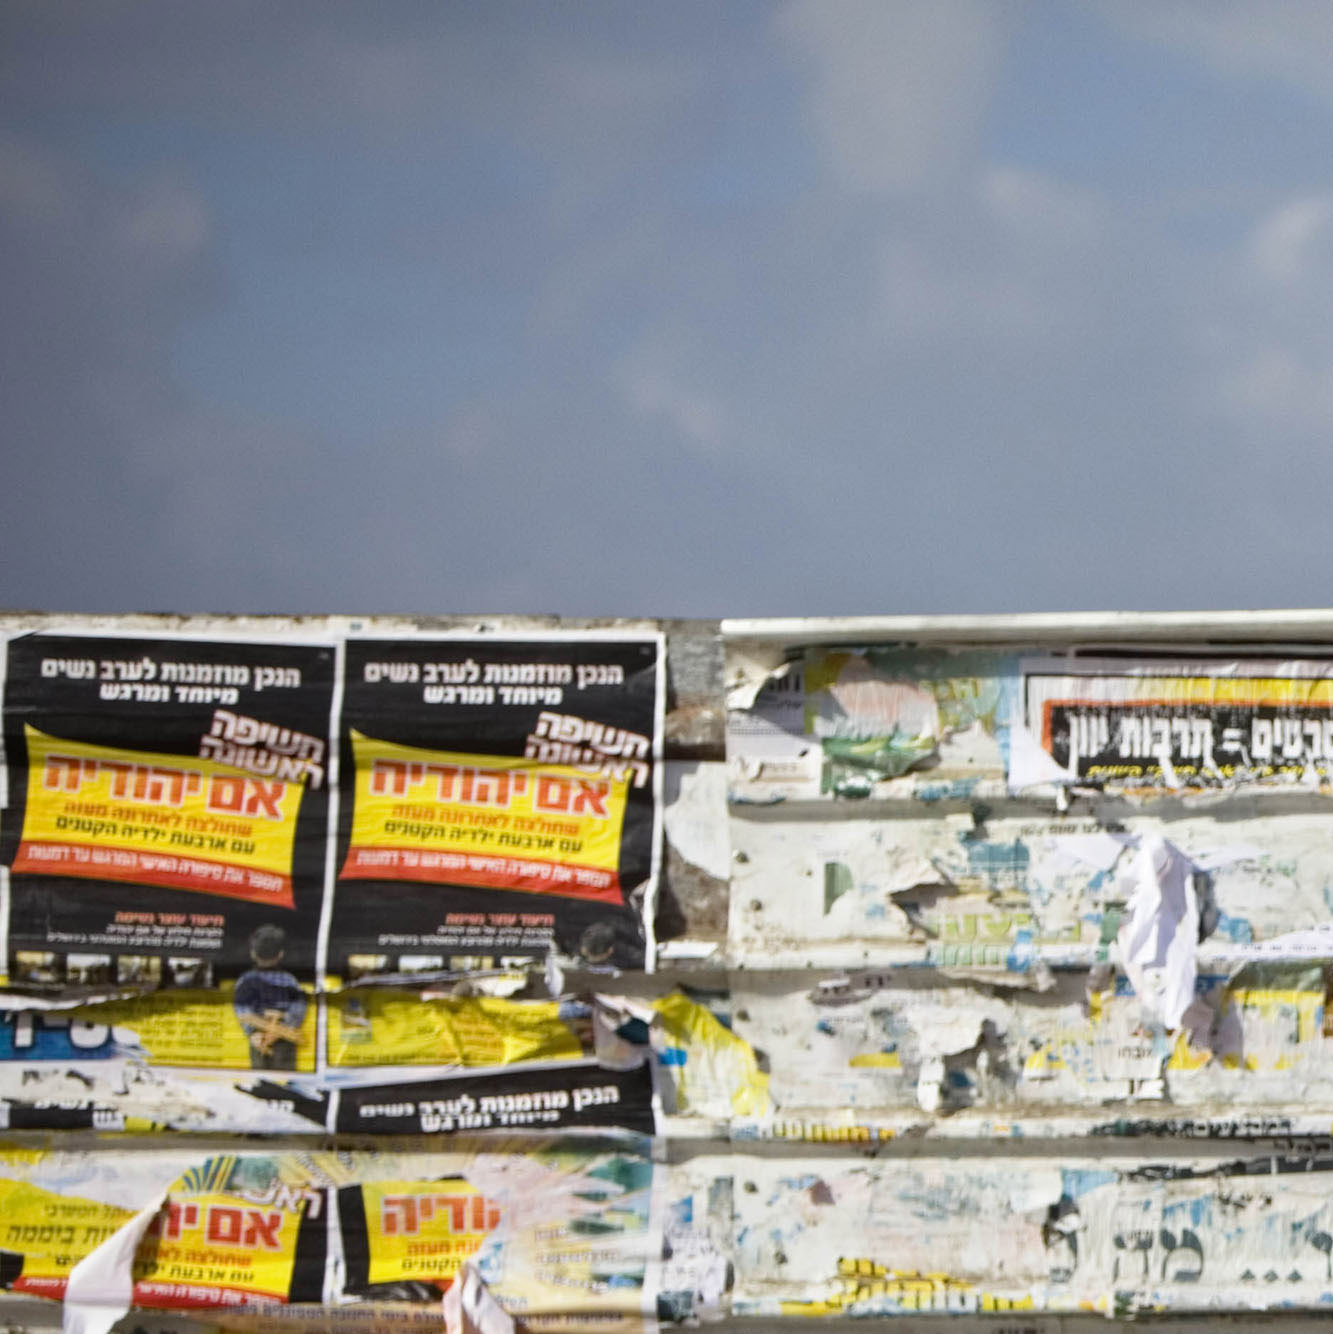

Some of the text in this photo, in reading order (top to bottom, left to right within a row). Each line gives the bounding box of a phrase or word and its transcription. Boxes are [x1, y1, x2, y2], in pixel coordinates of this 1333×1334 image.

[41, 657, 301, 691] הנכן מוזמנות לערב נשים
[364, 658, 624, 690] הנכן מוזמנות לערב נשים
[100, 683, 239, 705] מיוחד ומרגש
[423, 685, 563, 705] מיוחד ומרגש
[209, 709, 325, 763] חשיפה
[535, 711, 650, 760] חשיפה
[1120, 716, 1214, 760] תרבות
[200, 736, 324, 790] ראשונה
[524, 734, 649, 788] ראשונה
[42, 753, 287, 822] אם יהודיה
[368, 758, 611, 819] אם יהודיה
[55, 818, 256, 856] עם ארבעת ילדיה הקטנים
[384, 820, 583, 853] עם ארבעת ילדיה הקטנים
[419, 1094, 476, 1117] לערב
[481, 1088, 569, 1113] מוזמנות
[572, 1086, 620, 1111] הנכן
[420, 1112, 491, 1133] ומרגש
[204, 1203, 284, 1251] אם
[170, 1265, 256, 1283] עם ארבעת
